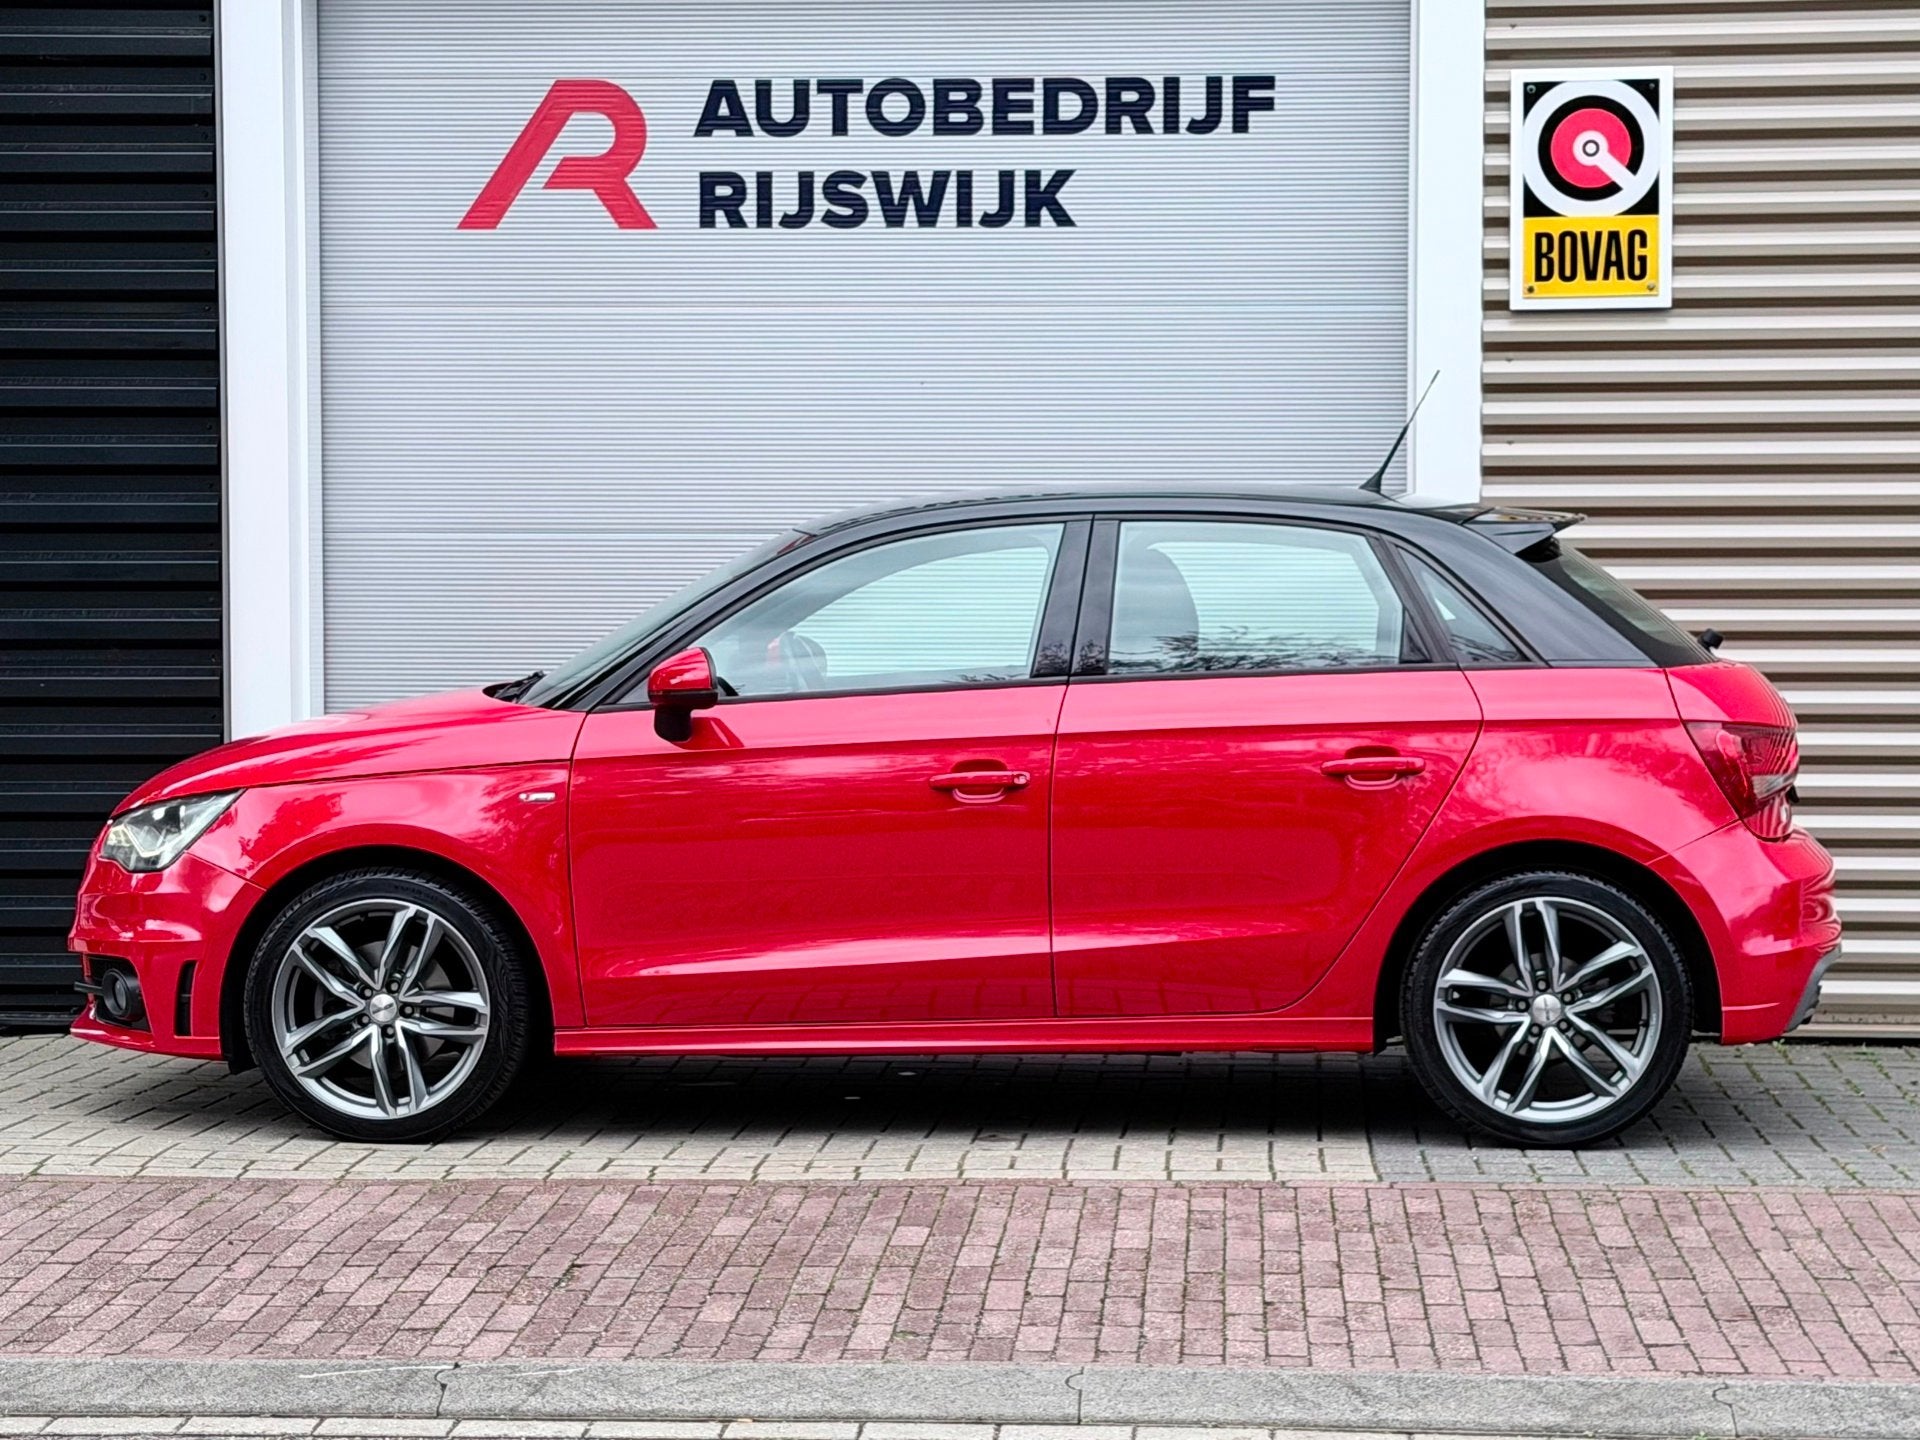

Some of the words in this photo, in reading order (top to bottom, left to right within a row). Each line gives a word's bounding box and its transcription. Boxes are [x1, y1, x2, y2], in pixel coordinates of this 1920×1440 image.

[694, 75, 1276, 137] AUTOBEDRIJF
[699, 169, 1076, 229] RIJSWIJK
[1534, 229, 1648, 283] BOVAG
